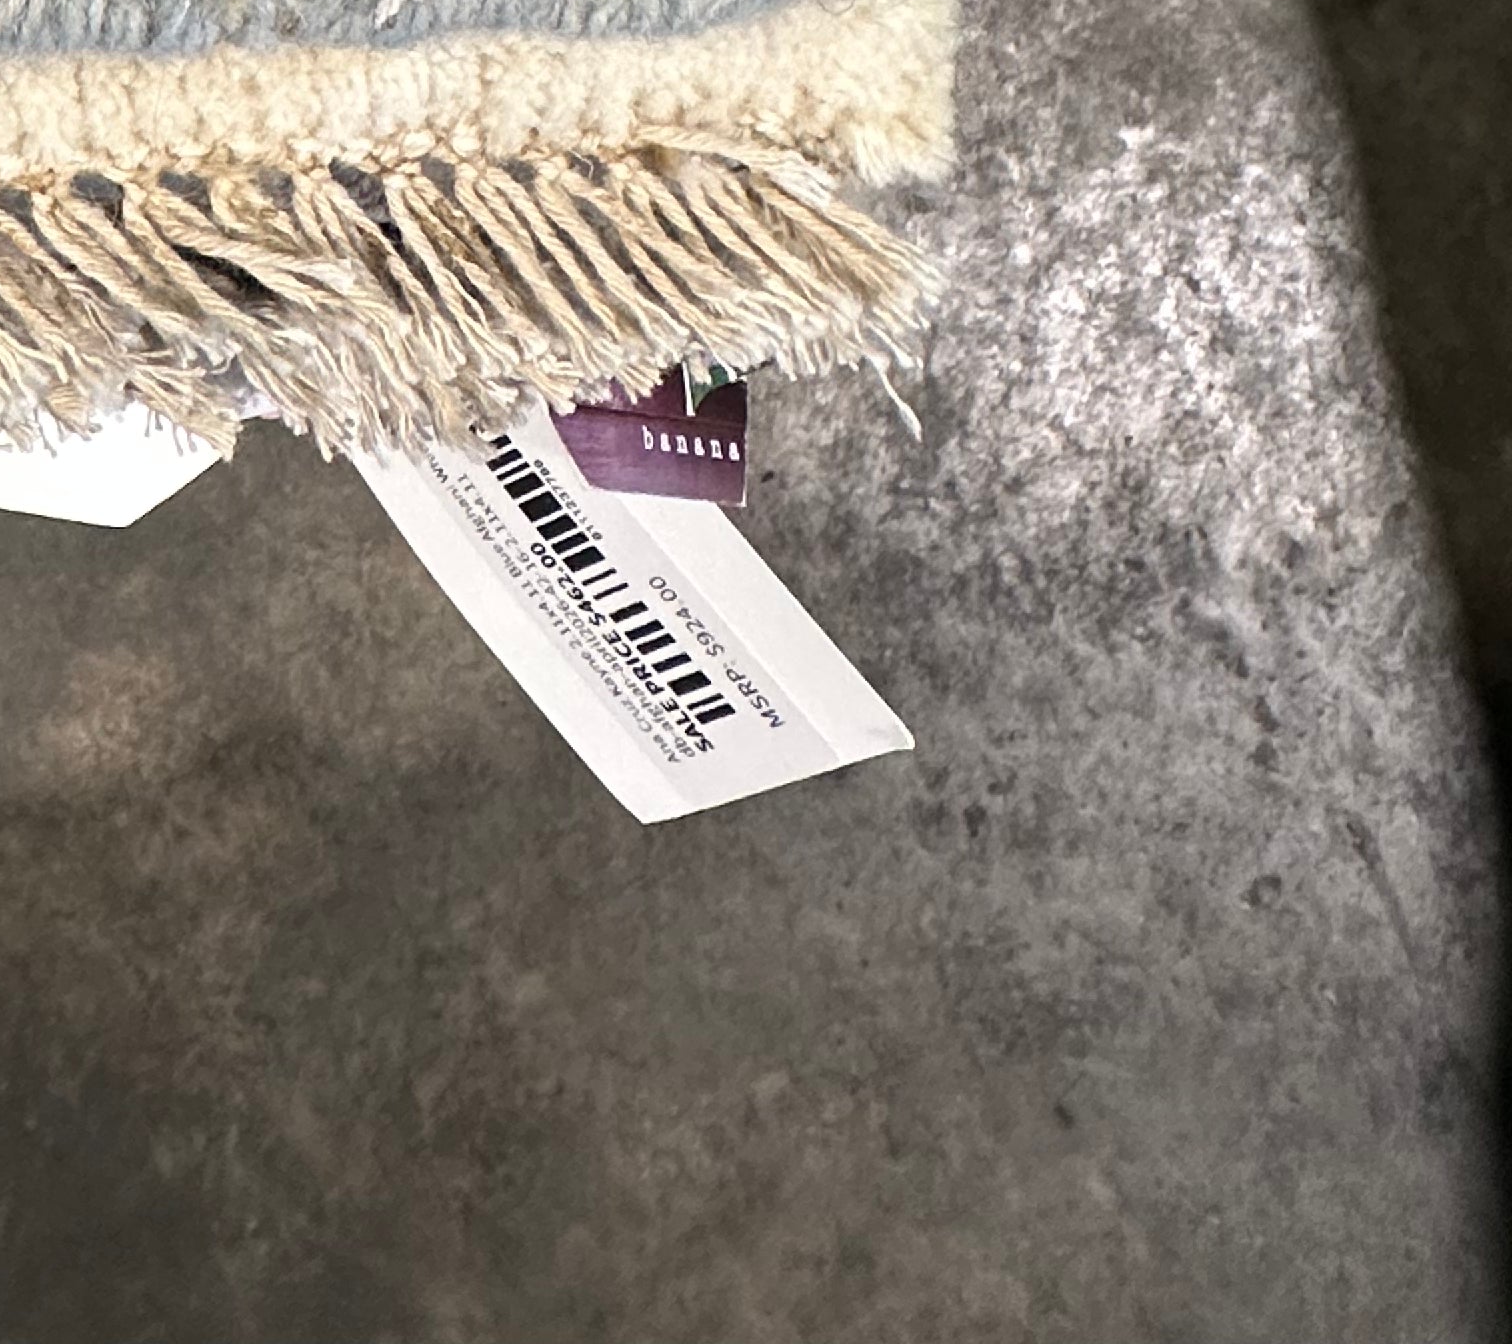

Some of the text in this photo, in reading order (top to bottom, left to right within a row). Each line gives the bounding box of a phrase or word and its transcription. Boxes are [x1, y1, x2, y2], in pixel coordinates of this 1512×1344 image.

[642, 424, 740, 462] banana
[493, 544, 522, 578] Blue
[530, 542, 715, 753] SALE PRICE $462.00
[649, 576, 786, 728] MSRP: $924.00
